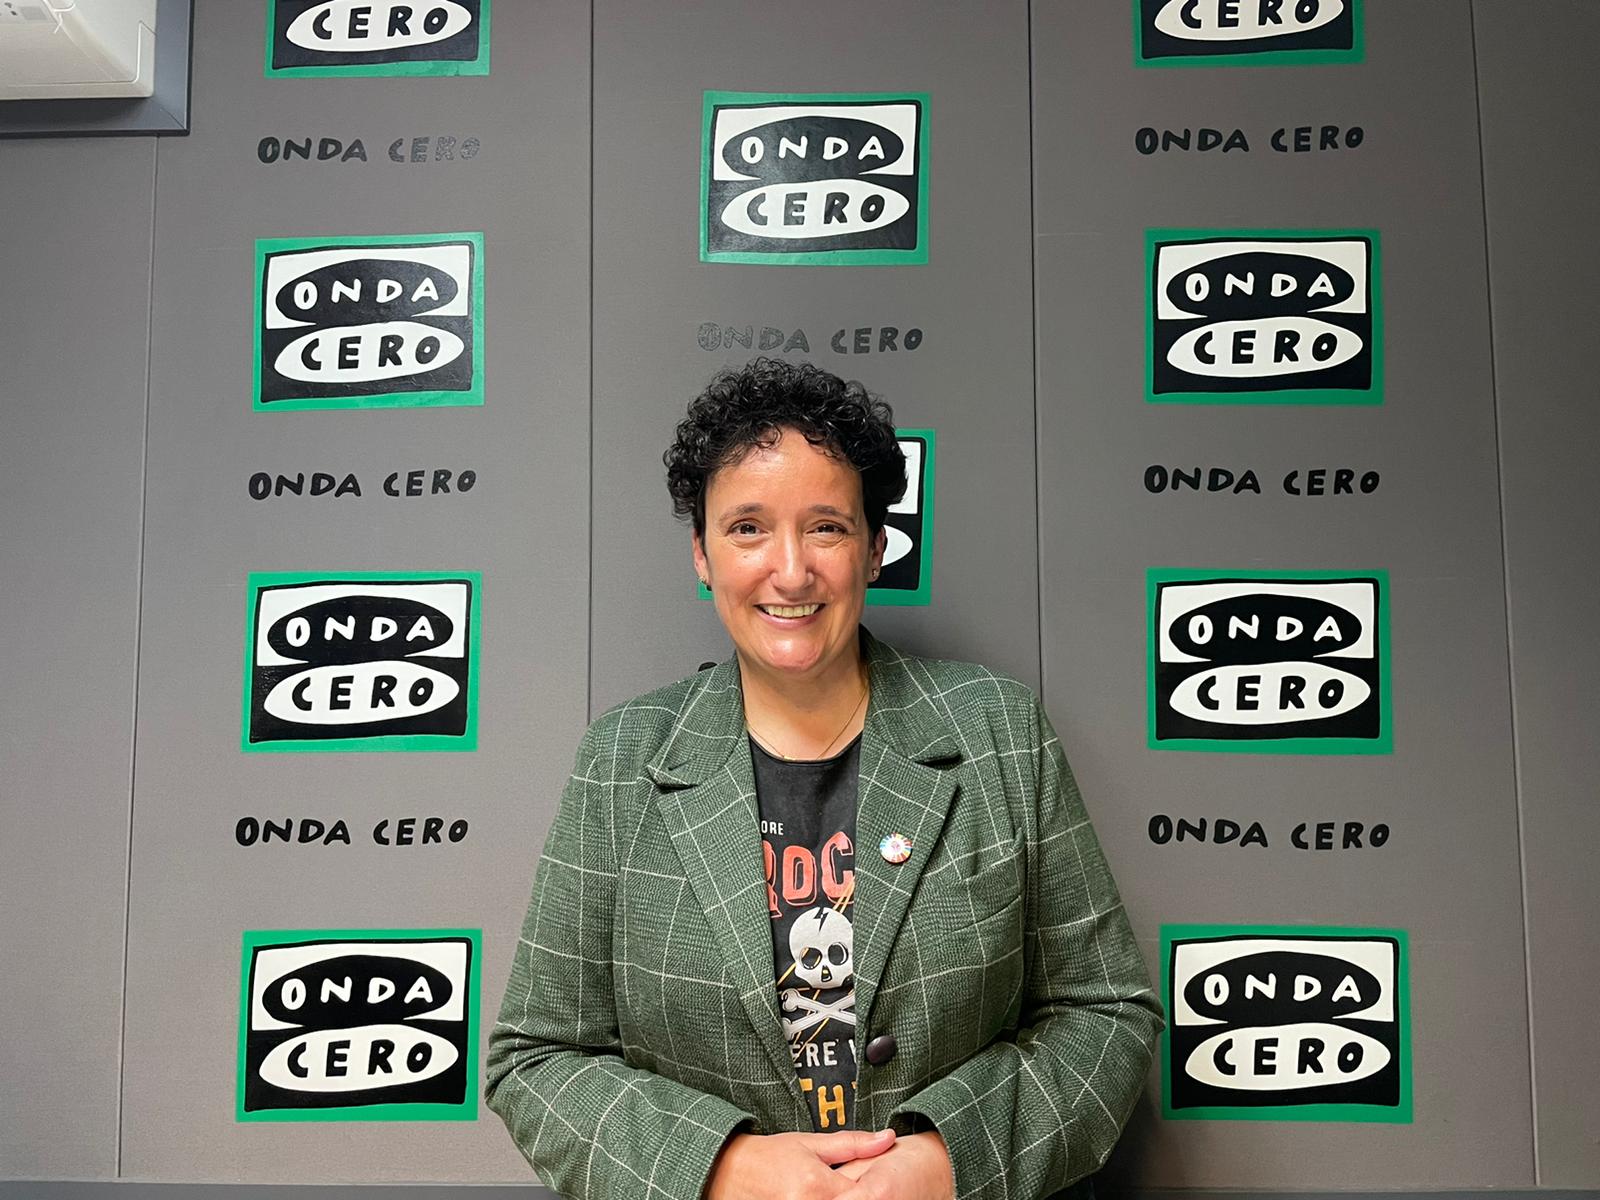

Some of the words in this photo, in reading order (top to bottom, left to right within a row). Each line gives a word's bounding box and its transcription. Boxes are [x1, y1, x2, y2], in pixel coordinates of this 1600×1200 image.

[312, 5, 449, 40] CERO
[1180, 0, 1320, 29] CERO
[257, 136, 368, 164] ONDA
[388, 136, 481, 163] CERO
[740, 135, 885, 165] ONDA
[1134, 126, 1250, 155] ONDA
[1270, 125, 1365, 153] CERO
[746, 191, 886, 226] CERO
[293, 276, 440, 310] ONDA
[1185, 271, 1336, 302] ONDA
[300, 334, 441, 371] CERO
[697, 322, 810, 353] ONDA
[830, 326, 923, 355] CERO
[1193, 329, 1338, 365] CERO
[248, 472, 362, 501] ONDA
[383, 469, 477, 497] CERO
[1143, 464, 1262, 496] ONDA
[1282, 468, 1381, 497] CERO
[285, 614, 435, 648] ONDA
[1188, 614, 1343, 645] ONDA
[291, 675, 435, 711] CERO
[1196, 675, 1345, 711] CERO
[235, 816, 351, 847] ONDA
[373, 817, 469, 846] CERO
[1147, 814, 1270, 848] ONDA
[1290, 821, 1390, 851] CERO
[281, 976, 435, 1011] ONDA
[1203, 972, 1362, 1006] ONDA
[287, 1039, 433, 1078] CERO
[1213, 1037, 1364, 1076] CERO
